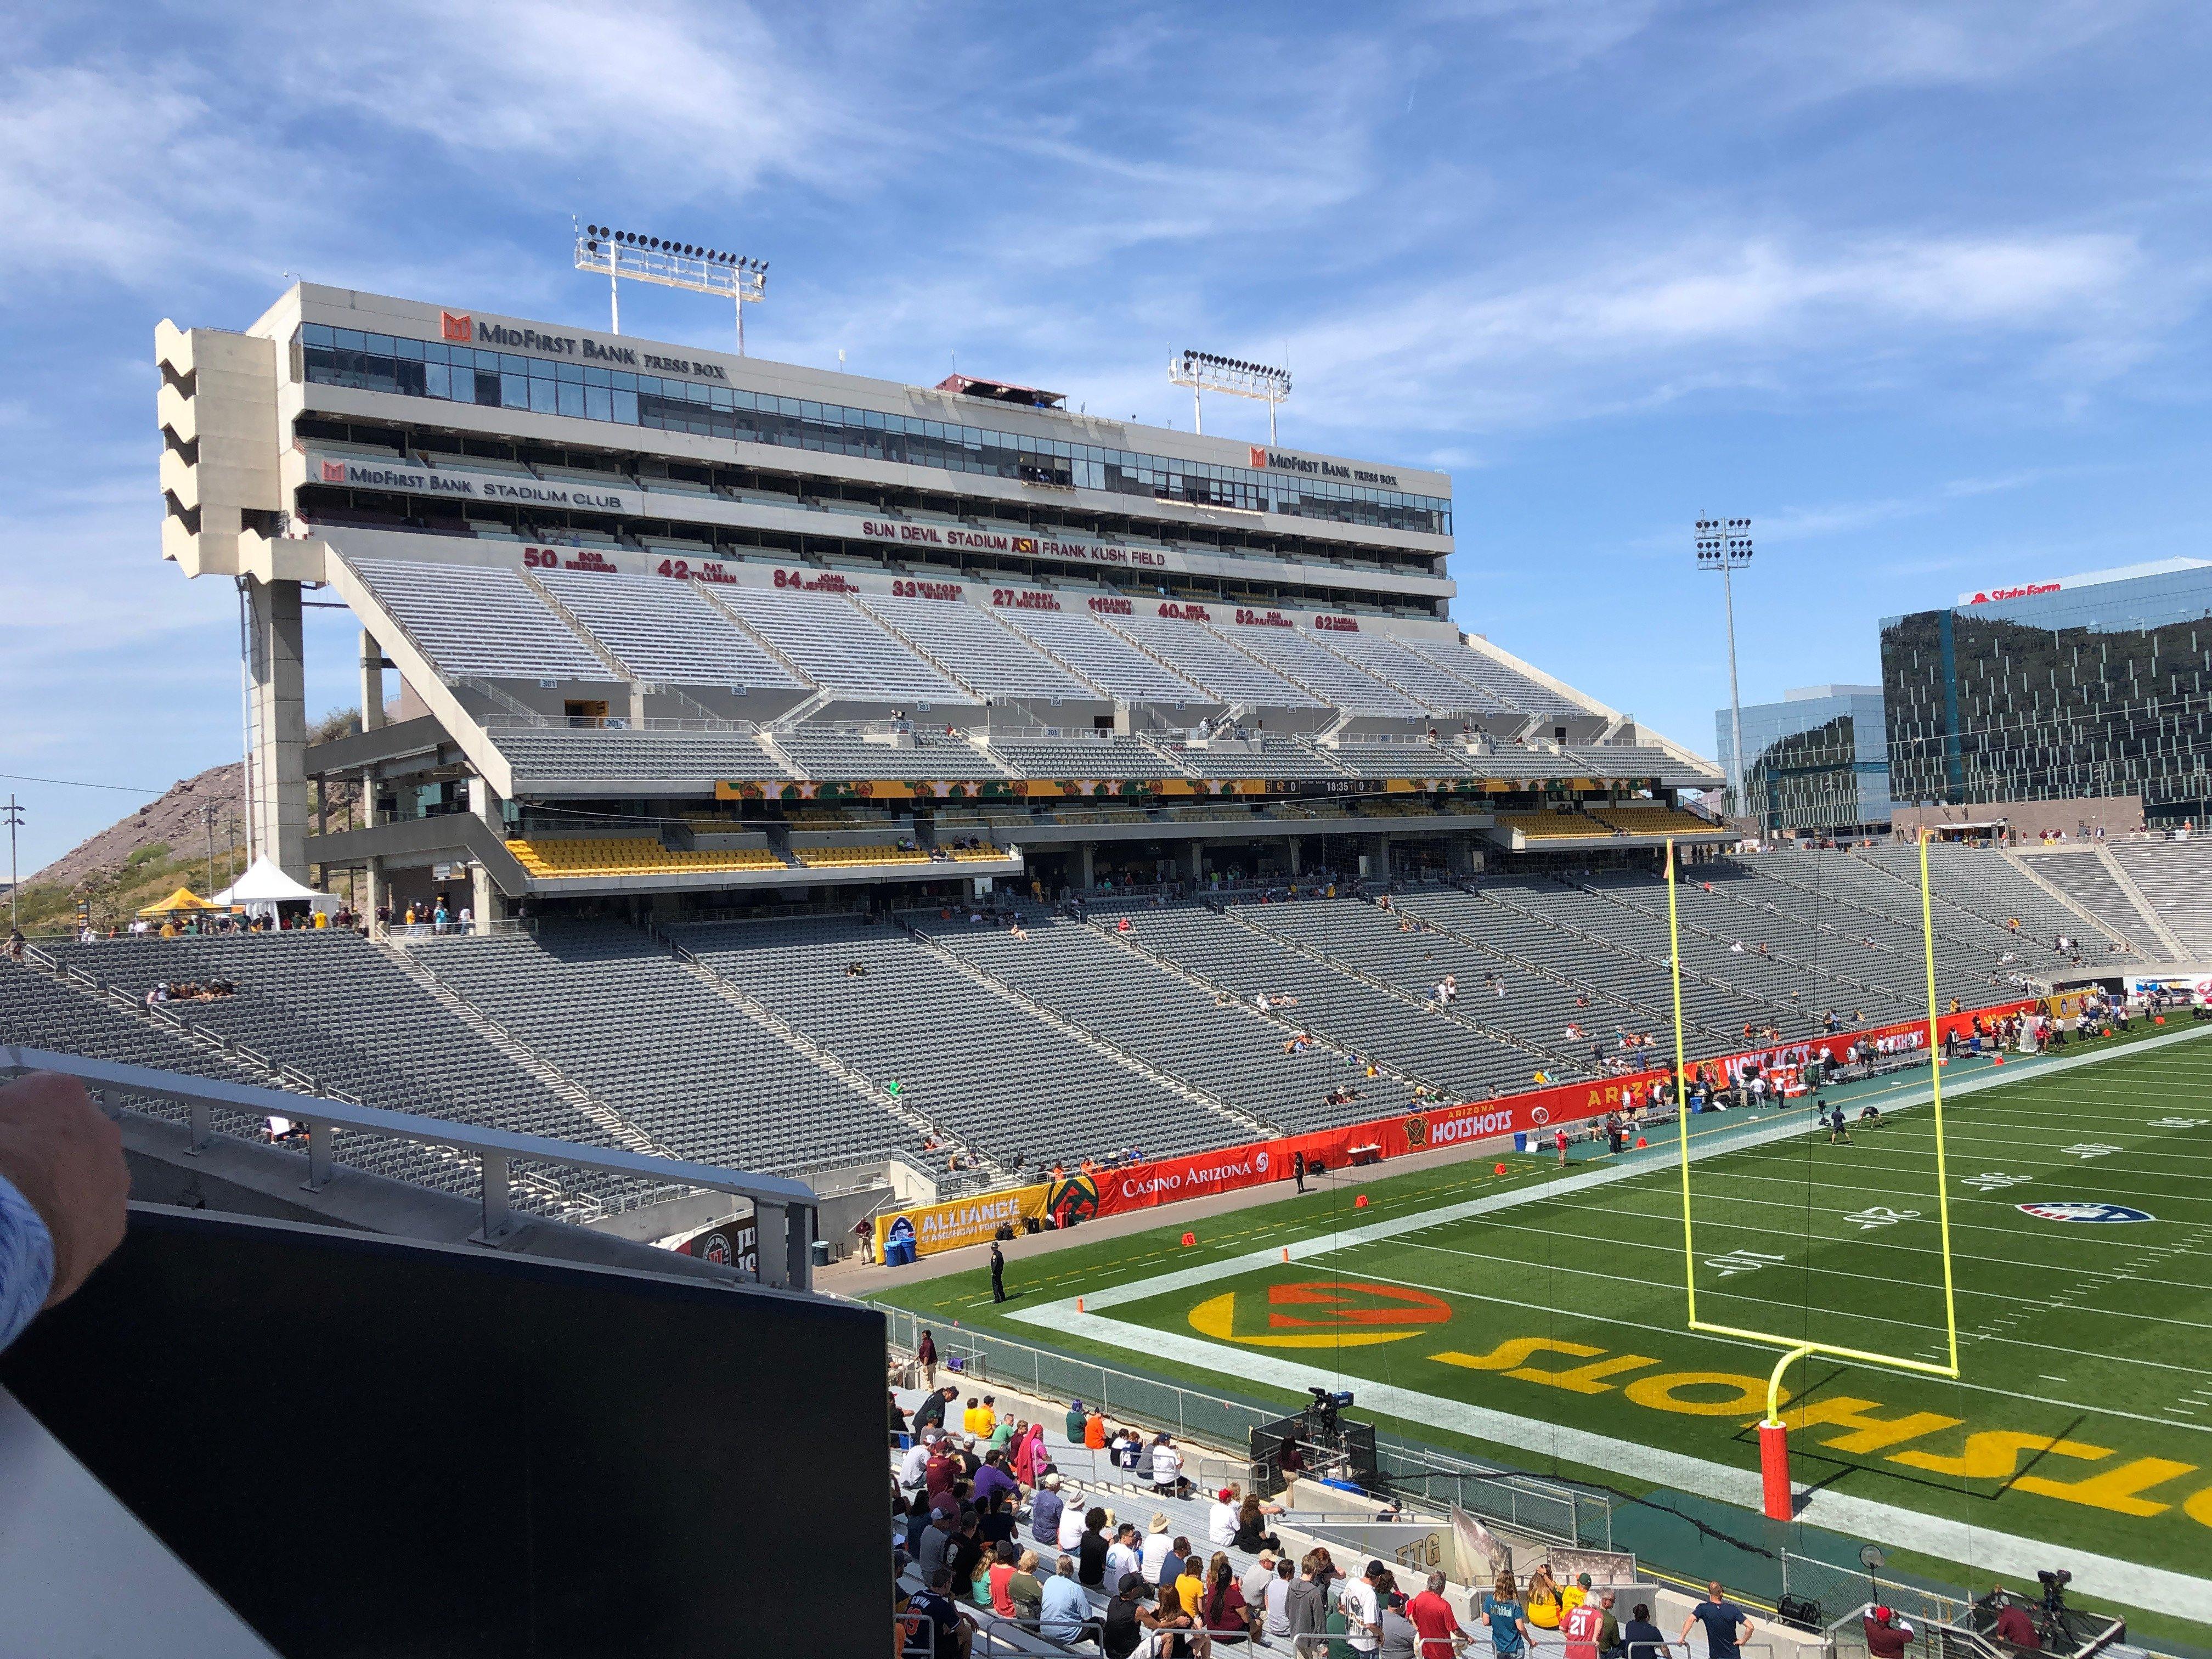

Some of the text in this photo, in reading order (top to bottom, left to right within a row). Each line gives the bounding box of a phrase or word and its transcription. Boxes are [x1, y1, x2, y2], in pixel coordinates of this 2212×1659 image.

[583, 338, 635, 364] BANK
[644, 354, 689, 374] PRESS
[692, 362, 724, 379] BOX
[1322, 461, 1350, 478] BANK
[1353, 470, 1378, 483] PRESS
[1380, 475, 1397, 486] BOX
[430, 475, 471, 493] BANK
[483, 483, 567, 503] STADIUM
[573, 493, 622, 508] CLUB
[863, 521, 895, 538] SUN
[901, 526, 942, 543] DEVIL
[947, 531, 1007, 550] STADIUM
[1042, 541, 1087, 559] FRANK
[1091, 546, 1127, 562] KUSH
[1131, 551, 1165, 566] FIELD
[523, 547, 557, 568] 50
[658, 559, 689, 580] 42
[774, 569, 802, 589] 84
[892, 580, 917, 597] 33
[992, 589, 1014, 606] 27
[1158, 603, 1180, 618] 40
[1235, 609, 1254, 624] 52
[1315, 615, 1333, 630] 62
[1290, 781, 1296, 792] 0
[1327, 782, 1348, 792] 18:35
[1359, 781, 1364, 791] 0
[1447, 1104, 1495, 1119] ARIZONA
[1432, 1110, 1513, 1144] HOTSHOTS
[2060, 1143, 2123, 1159] 40
[1122, 1167, 1252, 1198] CASINO ARIZONA
[1961, 1172, 2033, 1192] 30
[922, 1198, 1020, 1233] ALLIANCE
[1842, 1206, 1922, 1230] 20
[1703, 1249, 1785, 1277] 10
[1351, 1565, 1364, 1578] 40
[1569, 1615, 1587, 1636] 21
